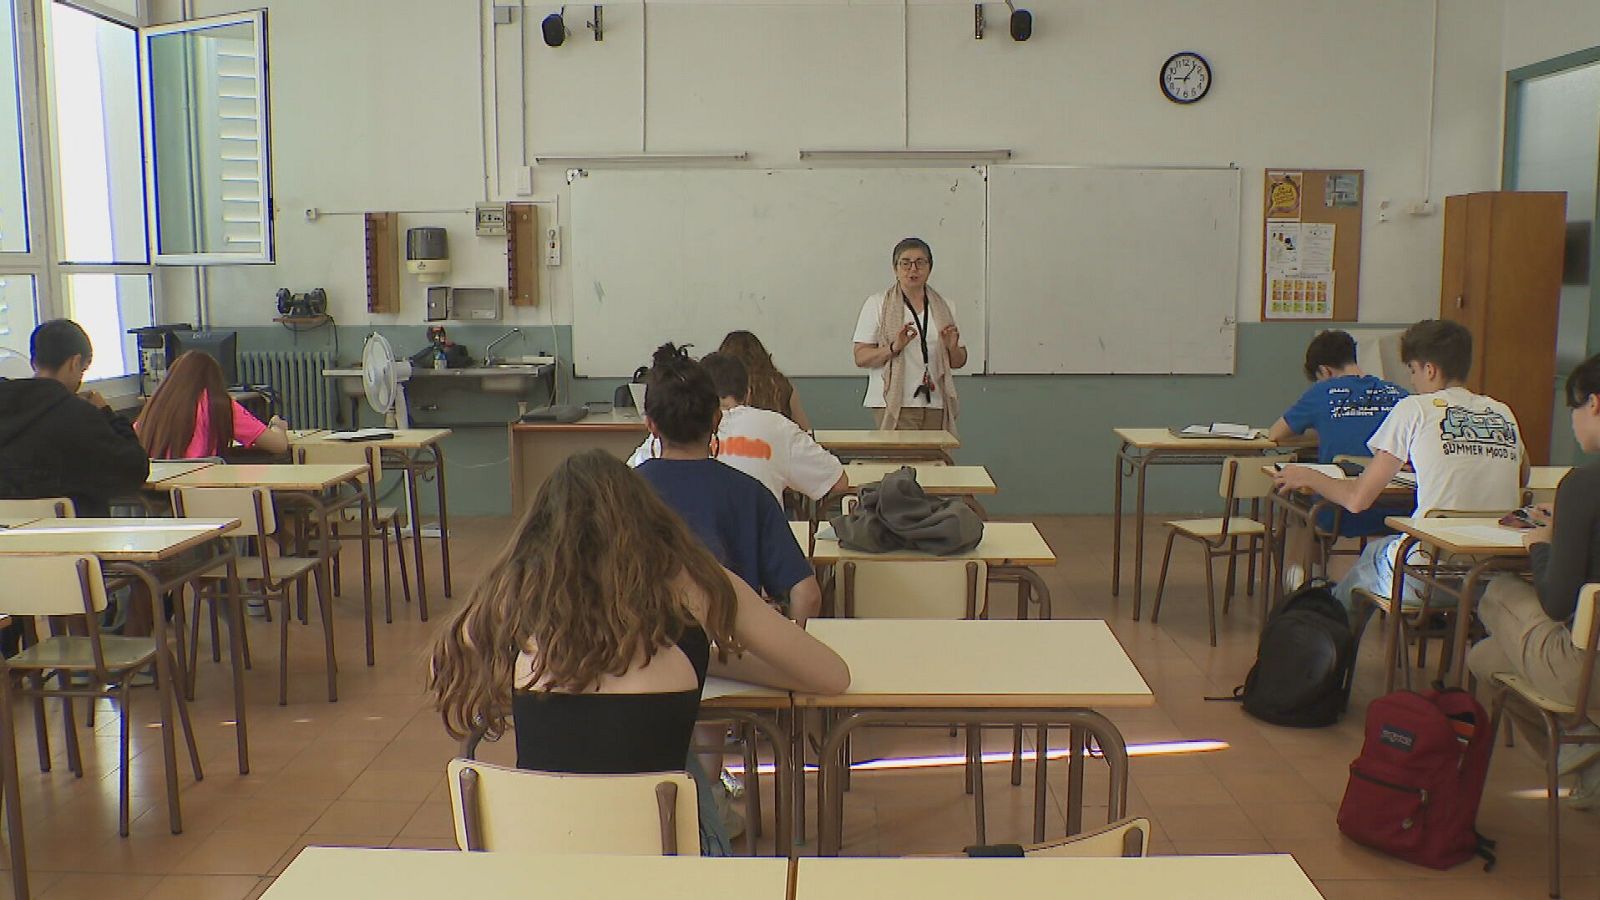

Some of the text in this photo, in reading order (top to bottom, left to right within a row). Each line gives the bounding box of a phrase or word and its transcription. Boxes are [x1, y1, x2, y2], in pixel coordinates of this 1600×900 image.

[1175, 60, 1181, 68] 11
[1442, 442, 1483, 456] SUMMER
[1486, 446, 1508, 459] MOOD
